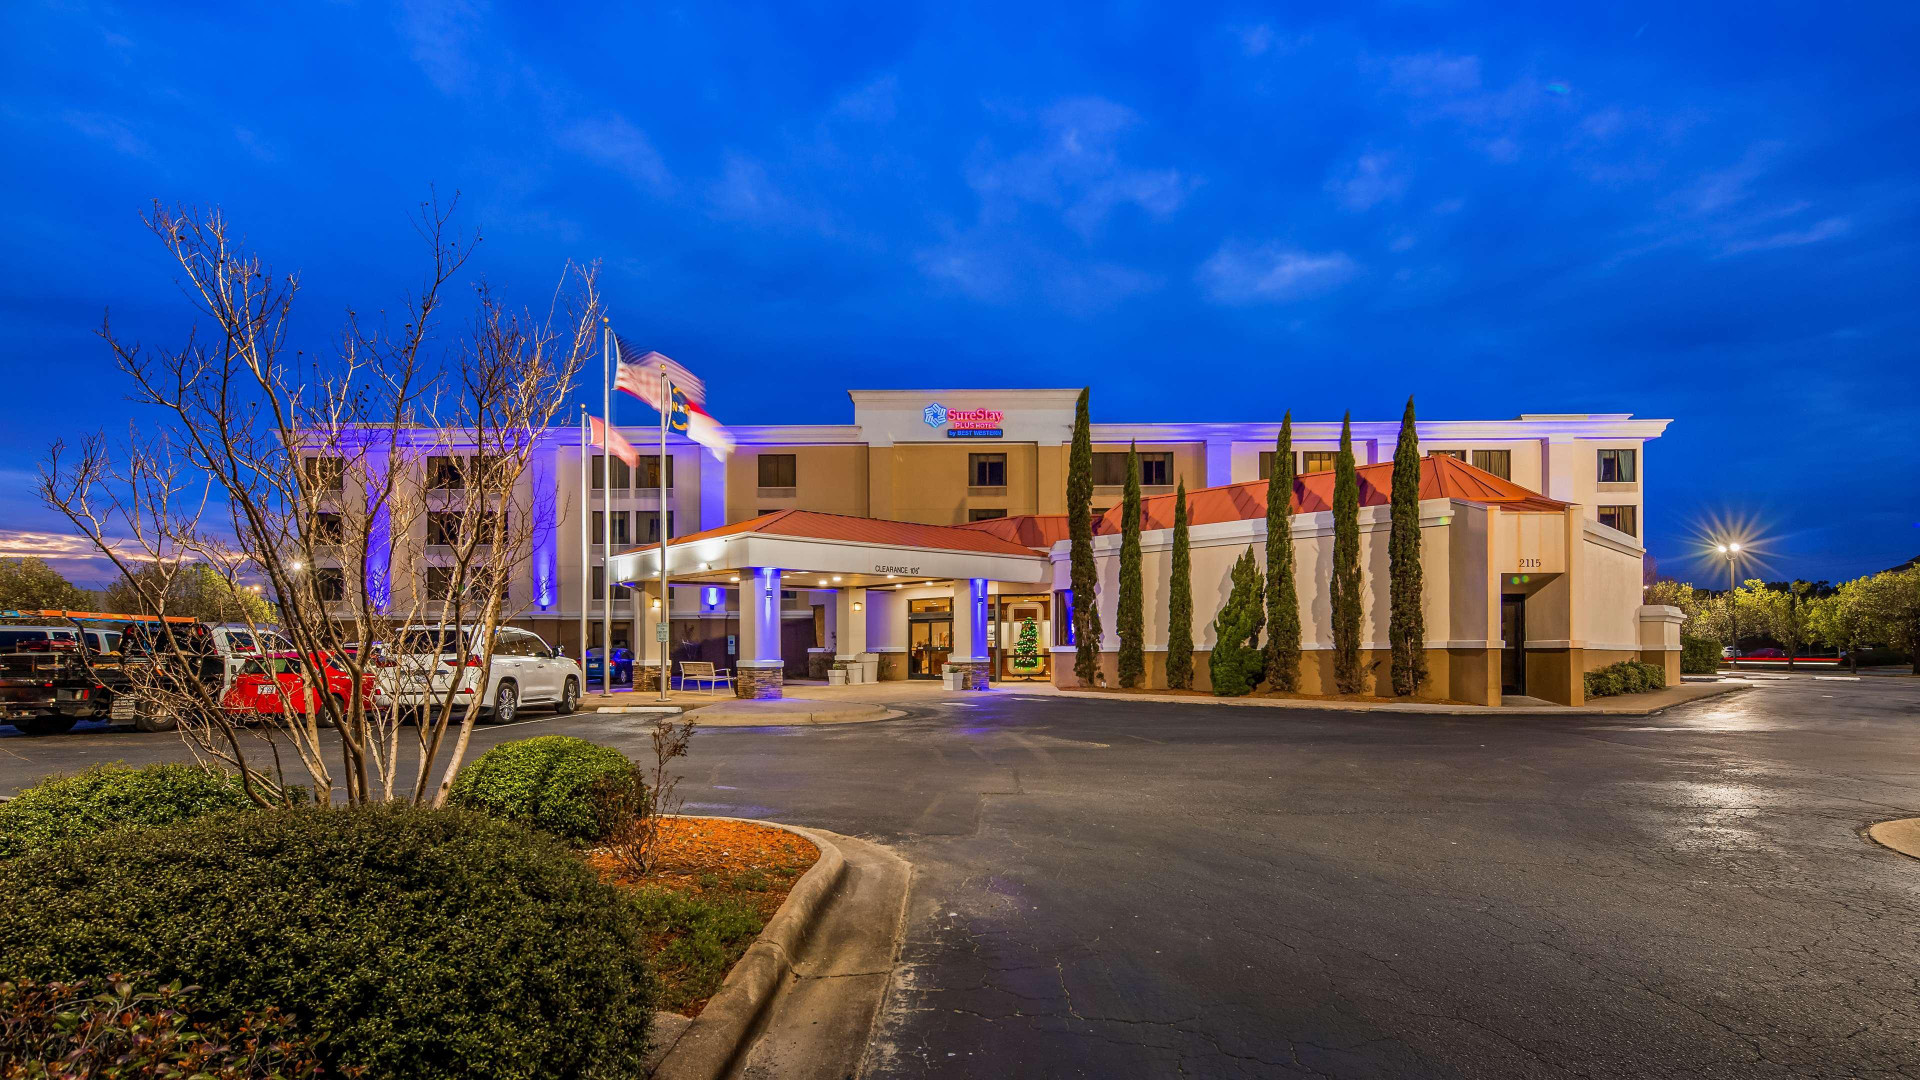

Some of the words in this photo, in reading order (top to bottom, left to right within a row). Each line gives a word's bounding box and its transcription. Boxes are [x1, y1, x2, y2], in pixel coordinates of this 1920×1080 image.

[947, 408, 1003, 424] SureStay
[1519, 558, 1542, 568] 2115
[875, 565, 908, 574] CLEARANCE
